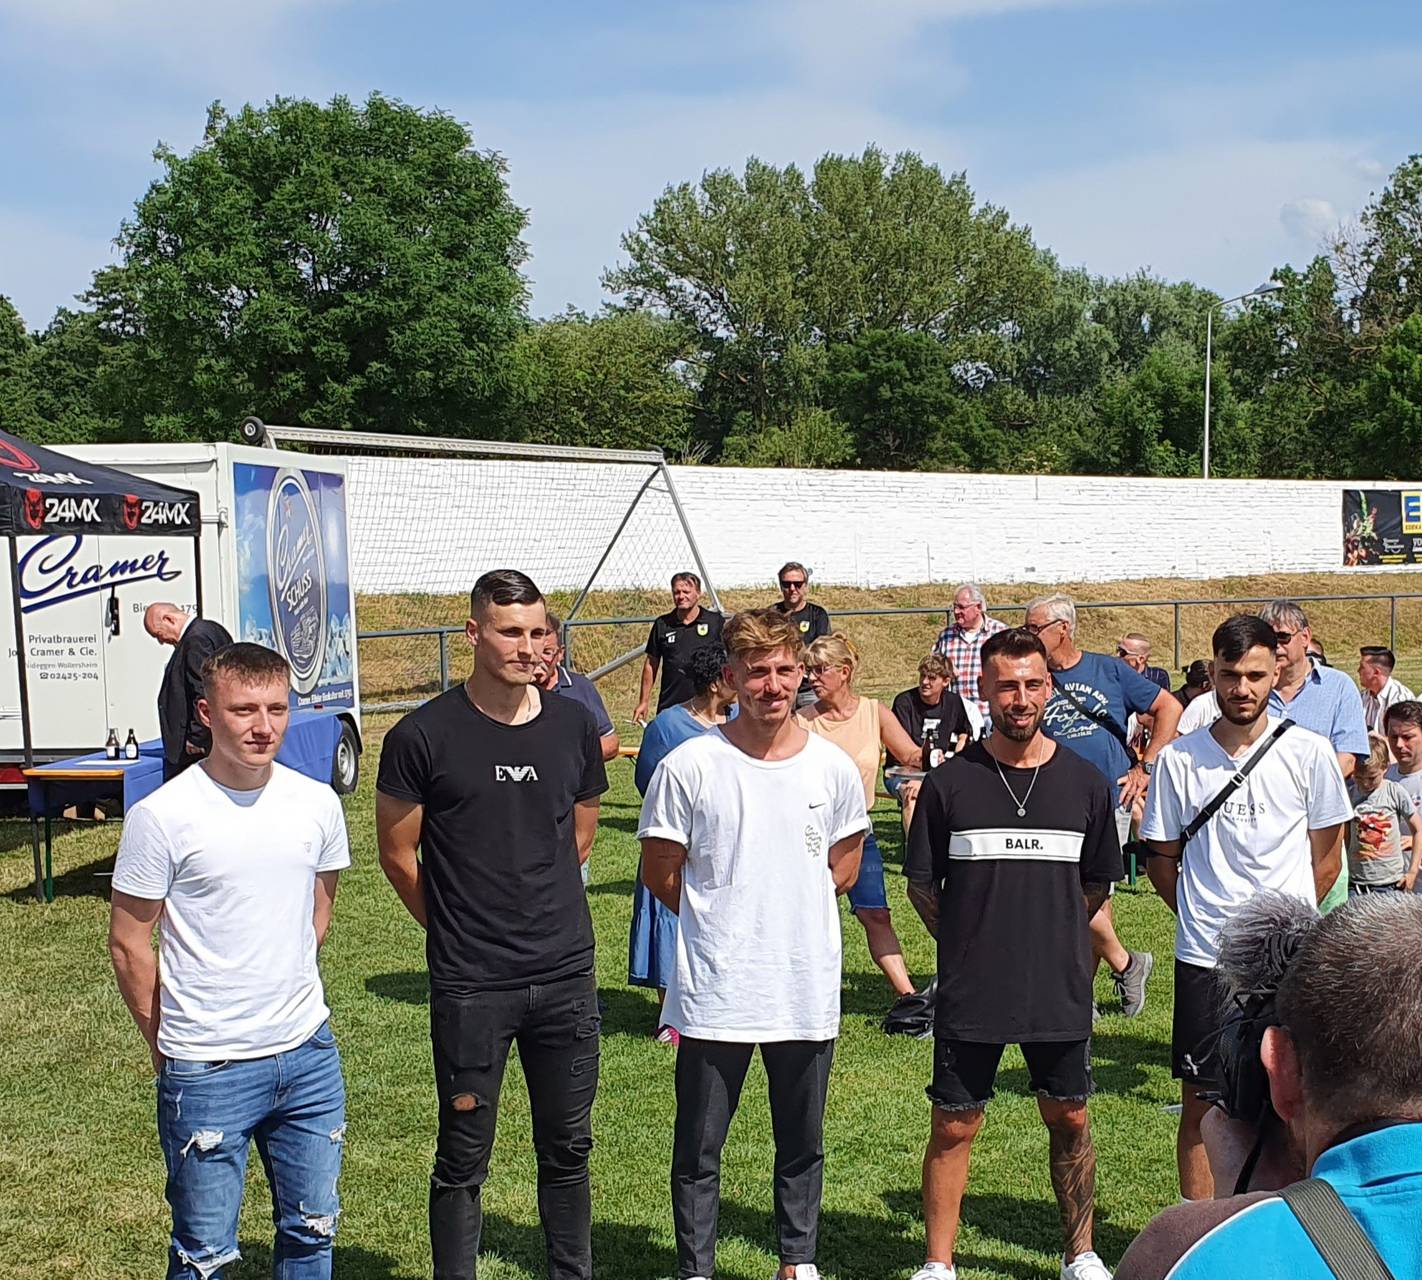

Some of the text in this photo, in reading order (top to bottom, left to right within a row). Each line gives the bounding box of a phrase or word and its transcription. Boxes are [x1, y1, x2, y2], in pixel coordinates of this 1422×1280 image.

[44, 498, 102, 523] 24MX
[141, 501, 191, 525] 24MX
[18, 535, 182, 600] Cramer
[28, 634, 97, 644] Privatbrauerei
[8, 647, 97, 658] Jo Cramer & Cie.
[50, 673, 99, 681] 02425-204
[1005, 838, 1044, 850] BALR.
